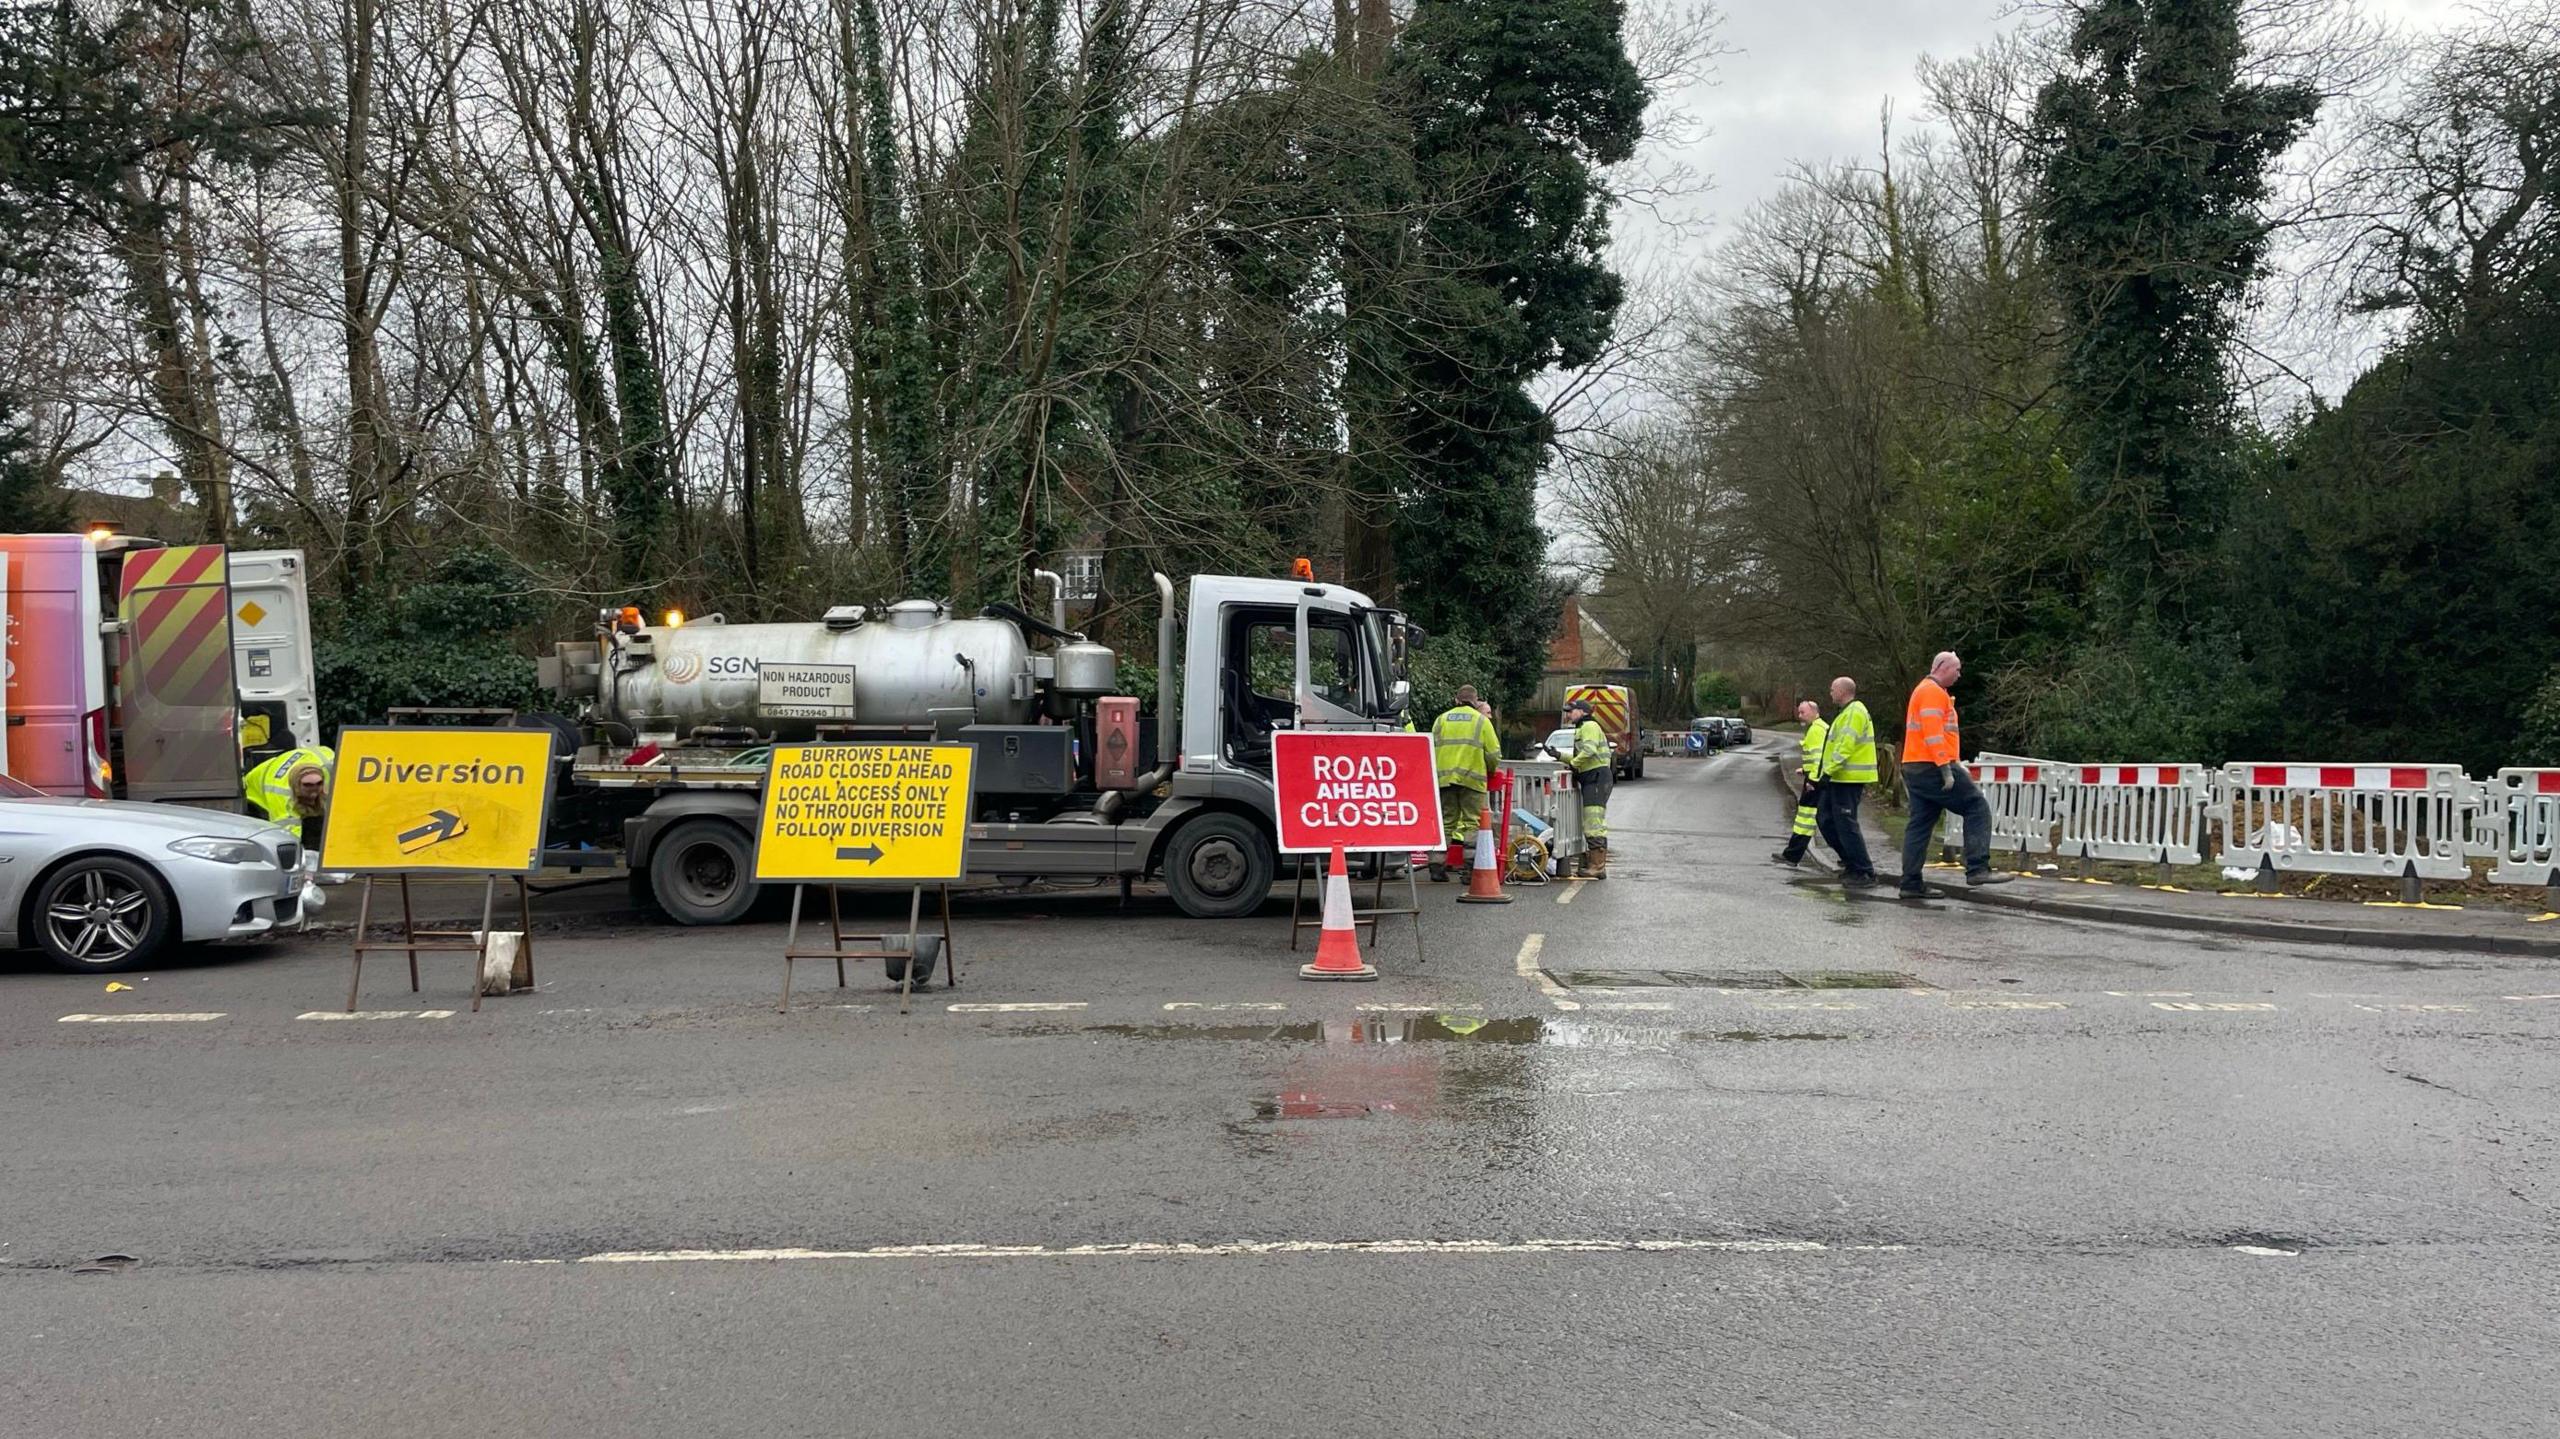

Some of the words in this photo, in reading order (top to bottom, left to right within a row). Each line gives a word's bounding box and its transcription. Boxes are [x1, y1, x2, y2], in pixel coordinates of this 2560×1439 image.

[708, 656, 759, 674] SGN
[763, 671, 785, 682] NON
[788, 672, 852, 684] HAZARDOUS
[782, 686, 831, 698] PRODUCT
[801, 748, 883, 762] BURROWS
[888, 748, 933, 762] LANE
[357, 756, 525, 785] Diversion
[780, 764, 824, 779] ROAD
[829, 763, 893, 779] CLOSED
[896, 763, 953, 780] AHEAD
[1313, 755, 1397, 781] ROAD
[778, 786, 831, 802] LOCAL
[836, 785, 901, 801] ACCESS
[906, 786, 950, 802] ONLY
[1316, 782, 1397, 800] AHEAD
[776, 803, 800, 819] NO
[805, 803, 885, 819] THROUGH
[891, 803, 947, 819] ROUTE
[1300, 801, 1419, 828] CLOSED
[776, 822, 846, 837] FOLLOW
[850, 822, 944, 837] DIVERSION
